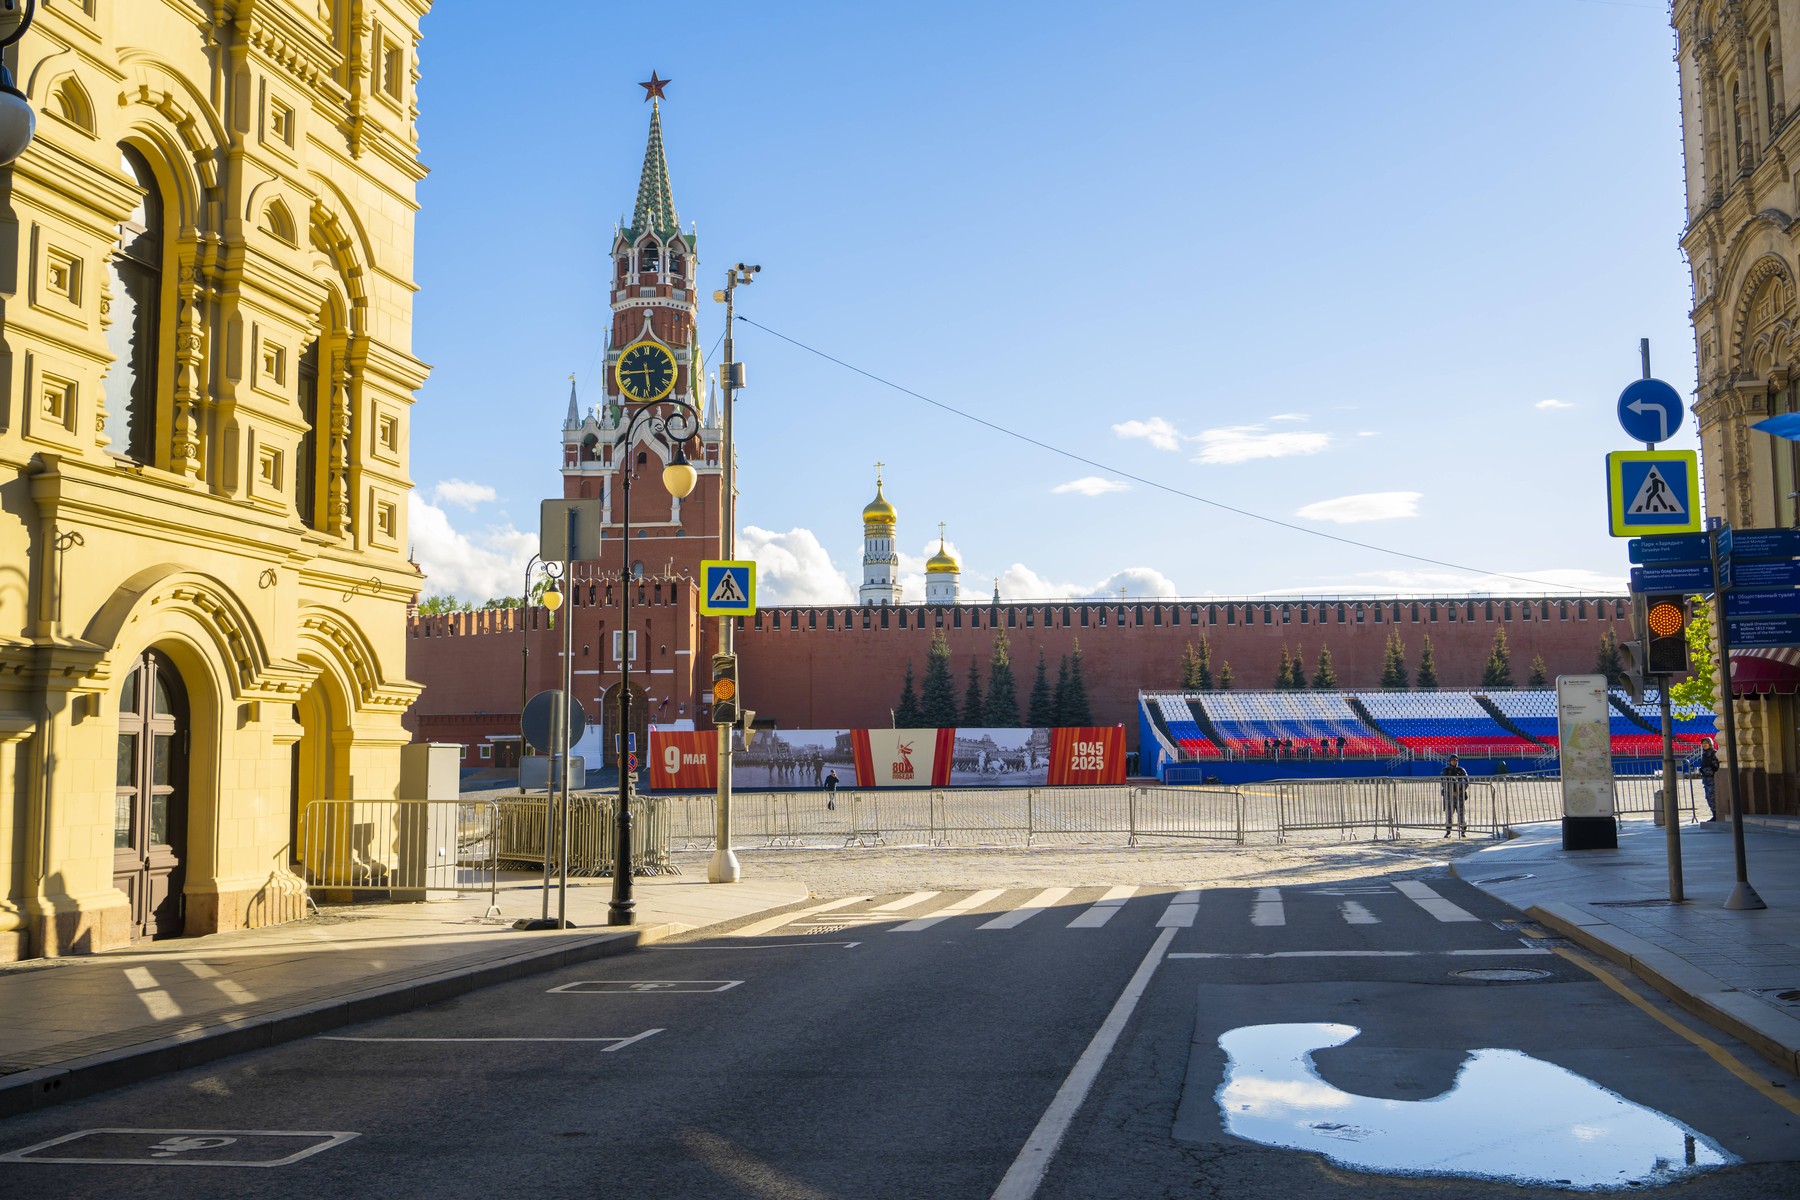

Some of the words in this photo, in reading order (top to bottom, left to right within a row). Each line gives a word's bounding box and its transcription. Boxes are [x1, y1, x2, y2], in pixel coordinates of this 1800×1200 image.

[1072, 742, 1104, 755] 1945
[665, 746, 680, 773] 9
[683, 754, 706, 765] МАЯ
[1072, 756, 1104, 770] 2025
[892, 762, 904, 773] 80
